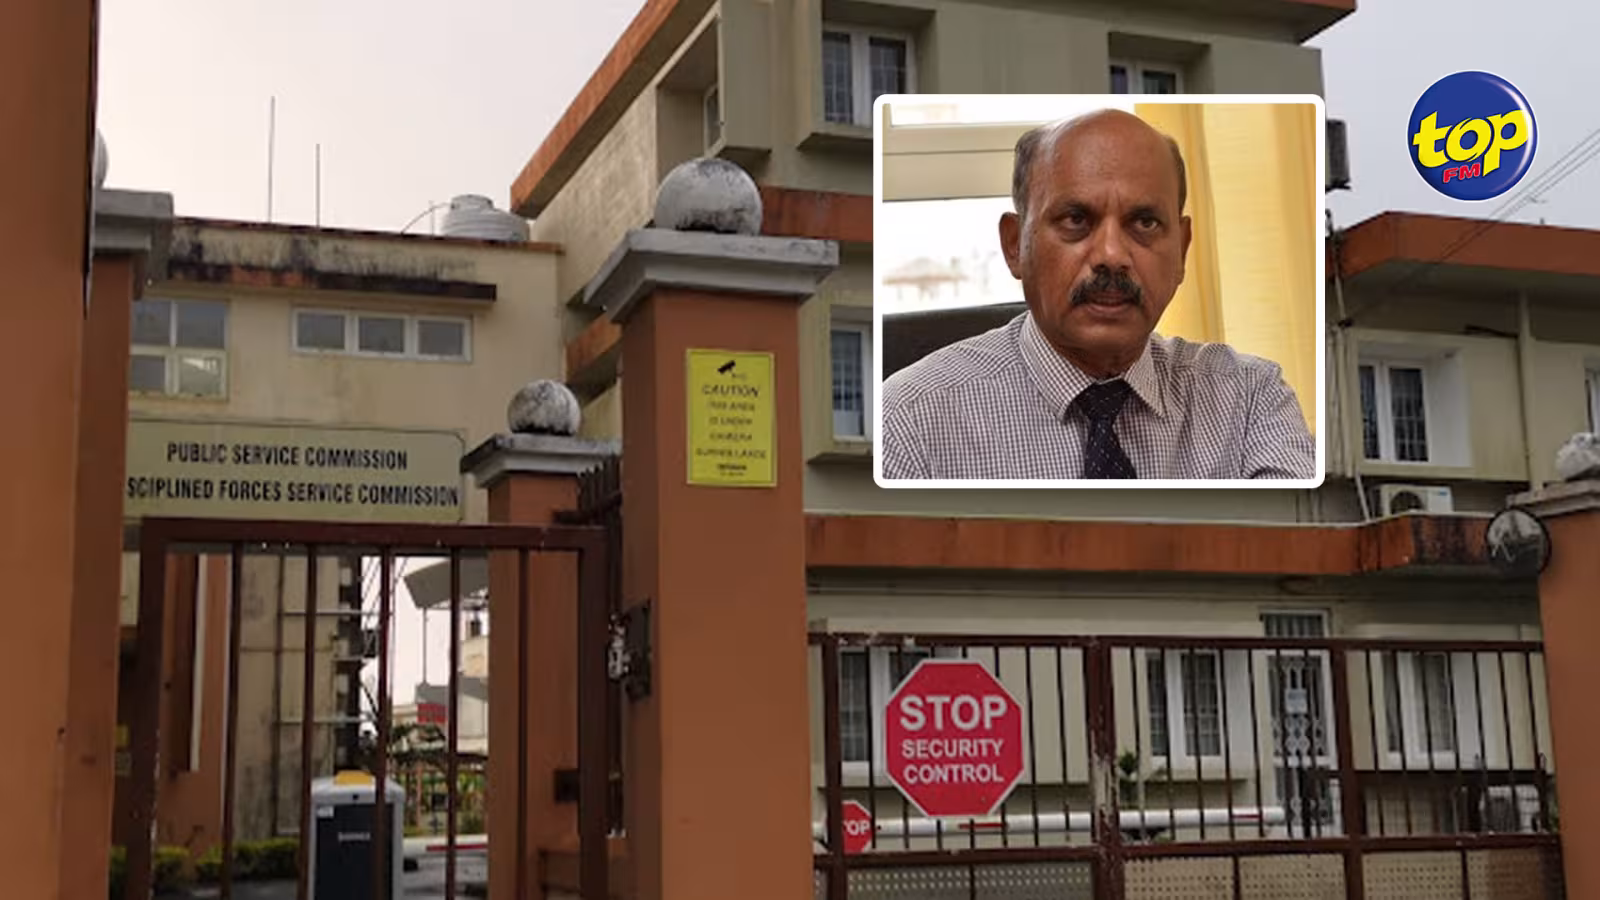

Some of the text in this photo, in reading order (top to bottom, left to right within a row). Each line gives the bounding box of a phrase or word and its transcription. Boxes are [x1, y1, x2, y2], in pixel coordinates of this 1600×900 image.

[702, 384, 759, 398] CAUTION
[167, 442, 408, 471] PUBLIC SERVICE COMMISSION
[127, 477, 459, 507] SCIPLINED FORCES SERVICE COMMISSION
[900, 694, 1007, 731] STOP
[901, 738, 1004, 759] SECURITY
[903, 763, 1004, 784] CONTROL
